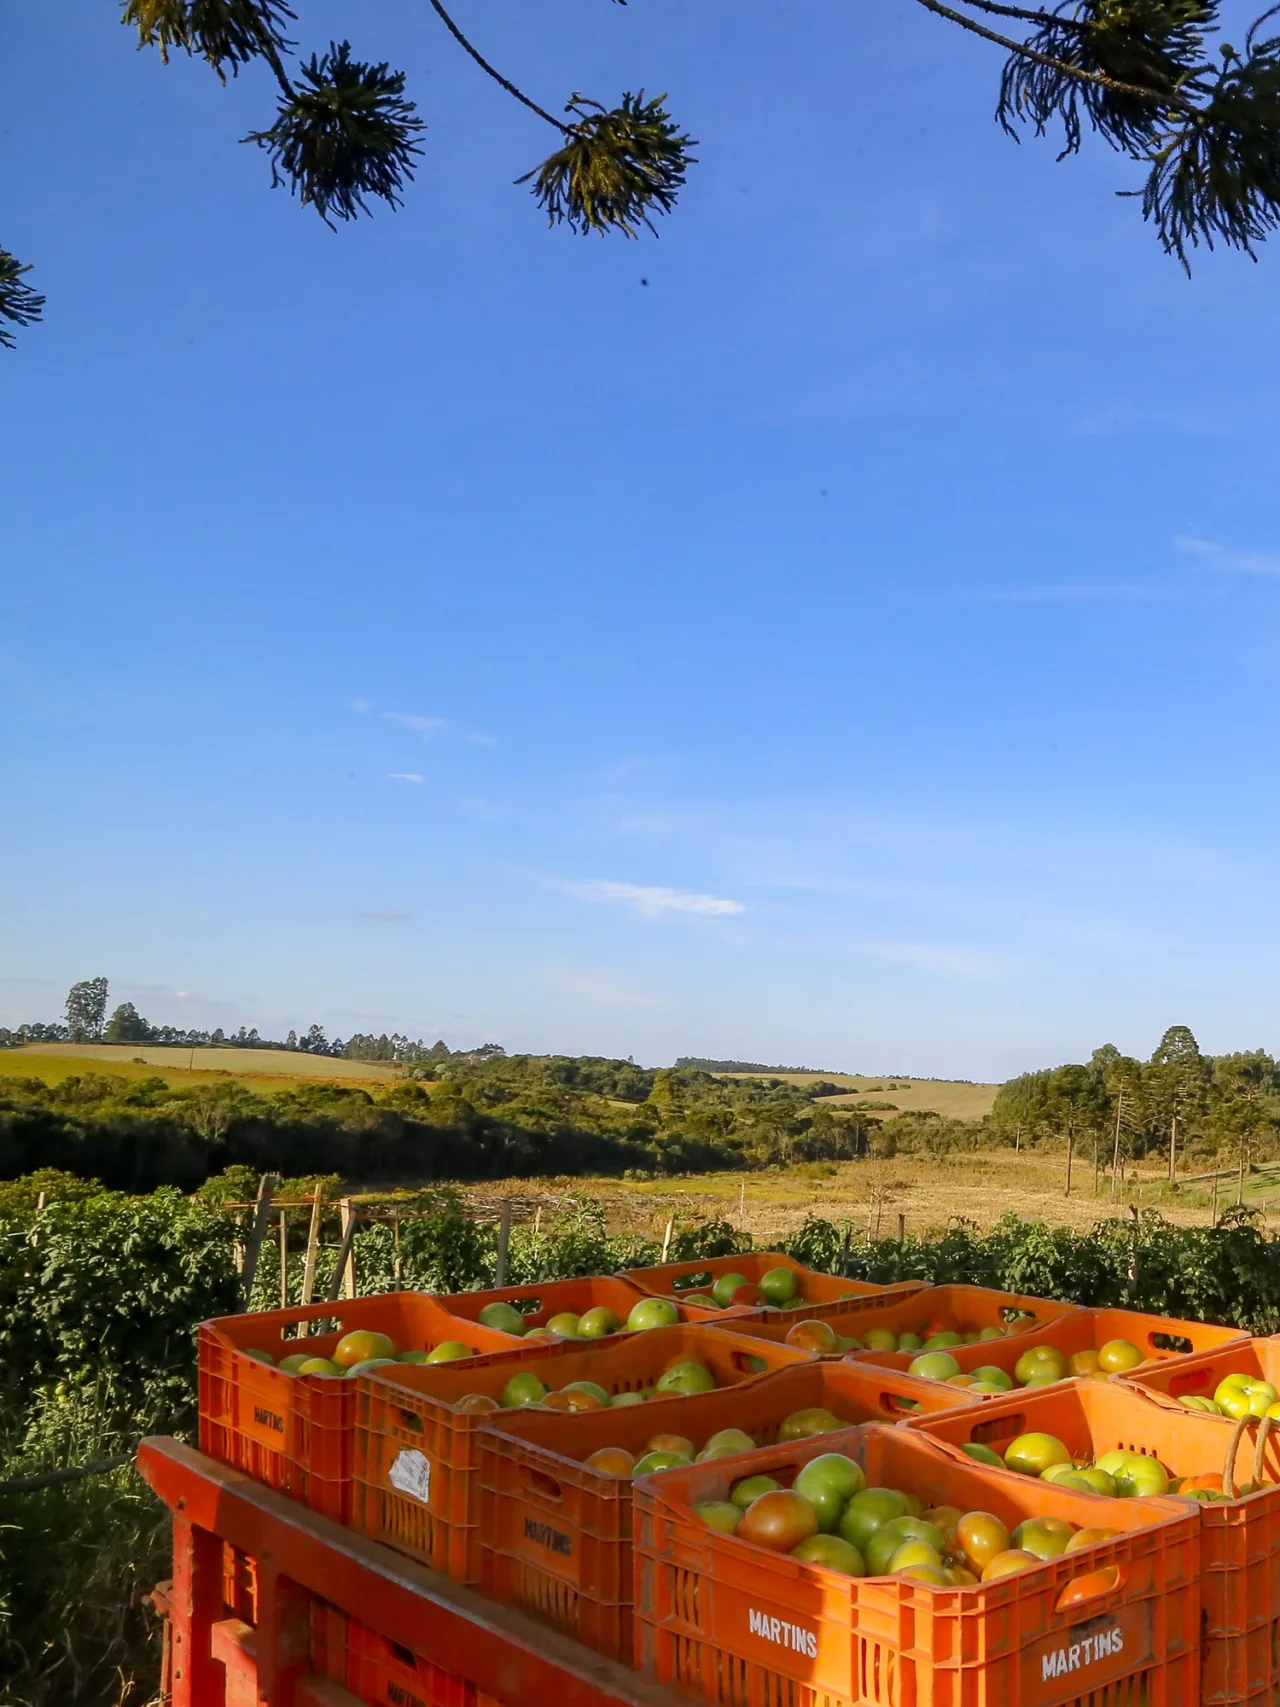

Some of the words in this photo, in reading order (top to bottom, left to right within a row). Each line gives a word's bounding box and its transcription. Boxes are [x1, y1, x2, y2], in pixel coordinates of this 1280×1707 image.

[254, 1405, 285, 1434] MARTINS
[524, 1516, 572, 1556] MARTINS
[748, 1608, 818, 1659] MARTINS
[1041, 1627, 1124, 1683] MARTINS
